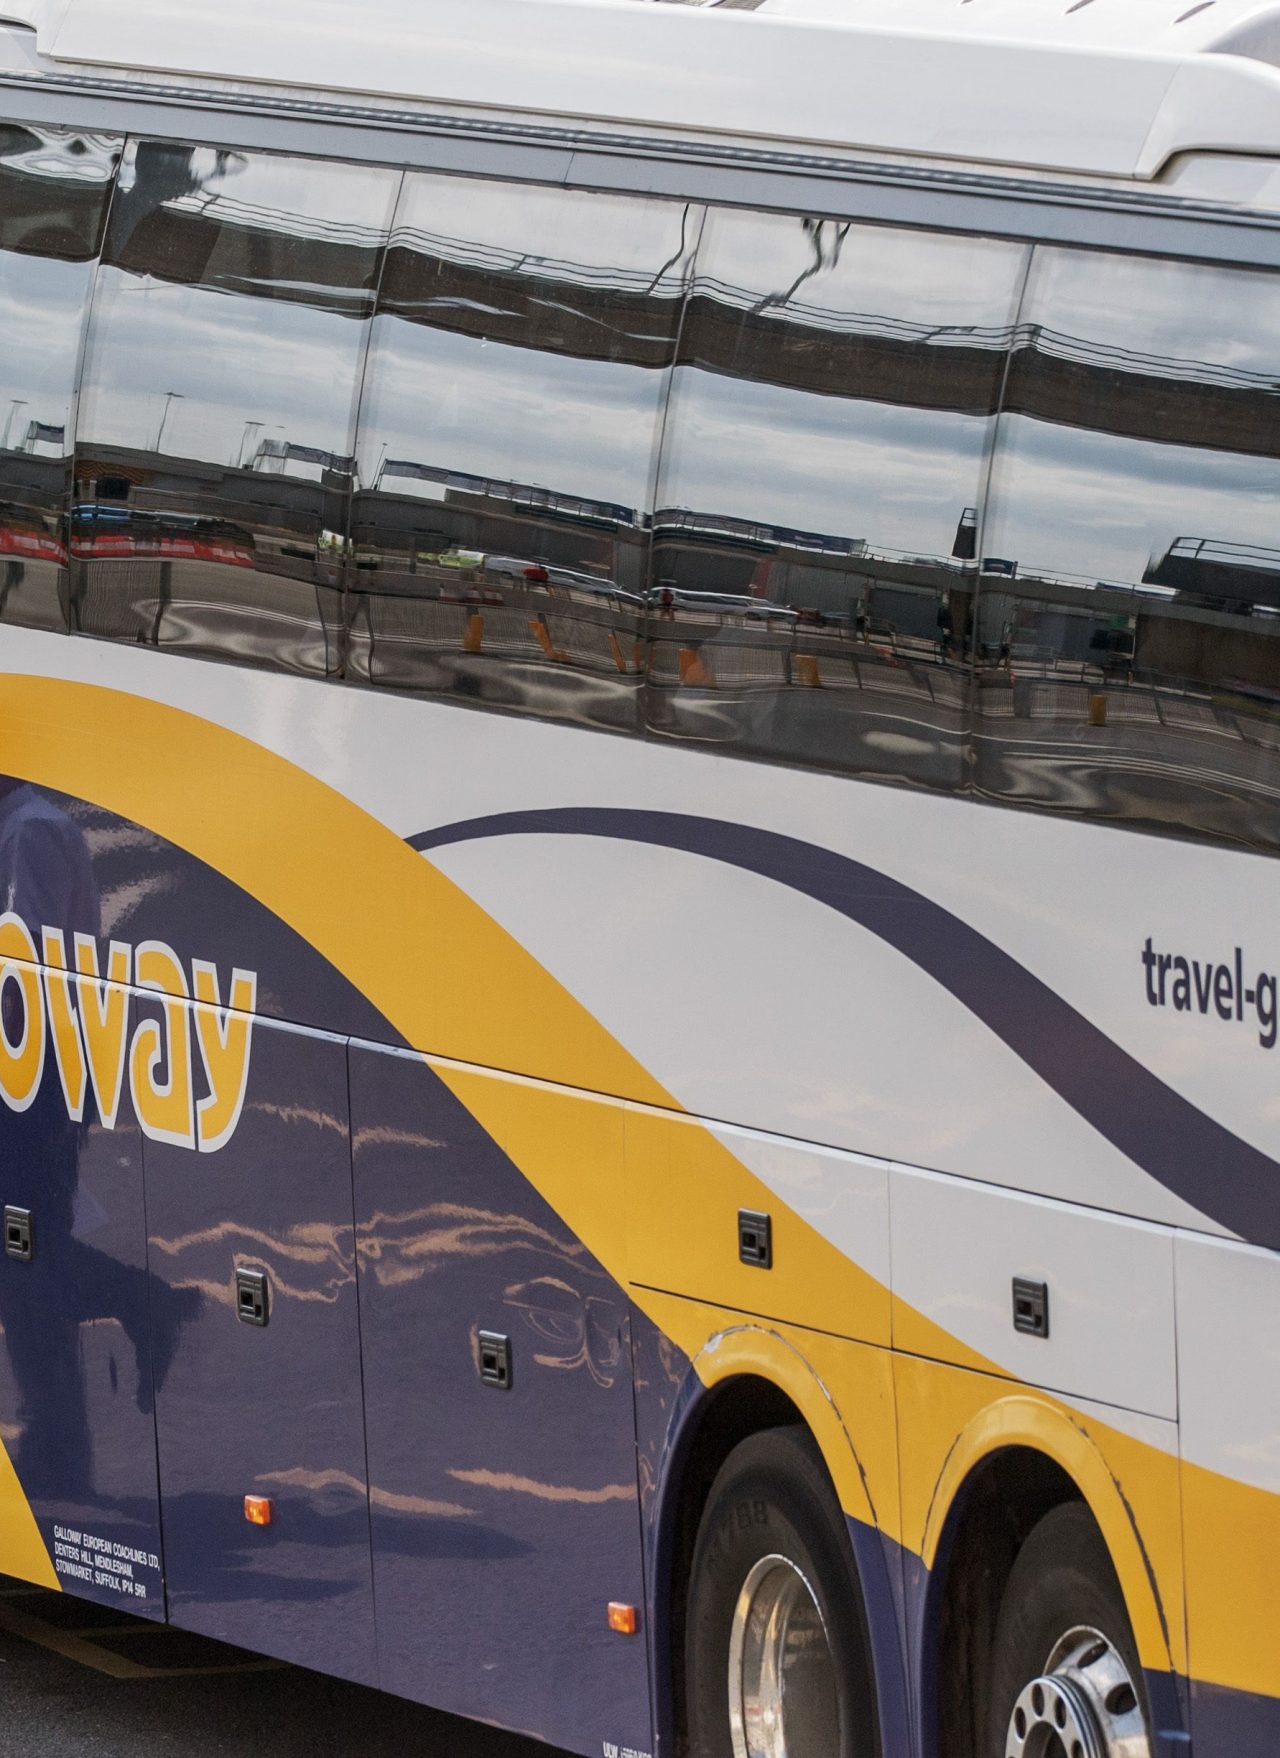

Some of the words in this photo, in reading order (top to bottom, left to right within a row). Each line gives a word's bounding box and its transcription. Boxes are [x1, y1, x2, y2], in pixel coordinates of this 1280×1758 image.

[1141, 936, 1277, 1050] travel-g
[54, 1525, 81, 1545] GALLOWAY
[83, 1533, 112, 1554] EUROPEAN
[113, 1543, 147, 1566] COACHLINES
[55, 1541, 79, 1561] DENTERS
[80, 1550, 94, 1568] HILL,
[95, 1554, 133, 1580] MENDLESHAM,
[56, 1559, 94, 1584] STOWMARKET,
[95, 1571, 121, 1592] SUFFOLK,
[122, 1580, 133, 1594] IP14
